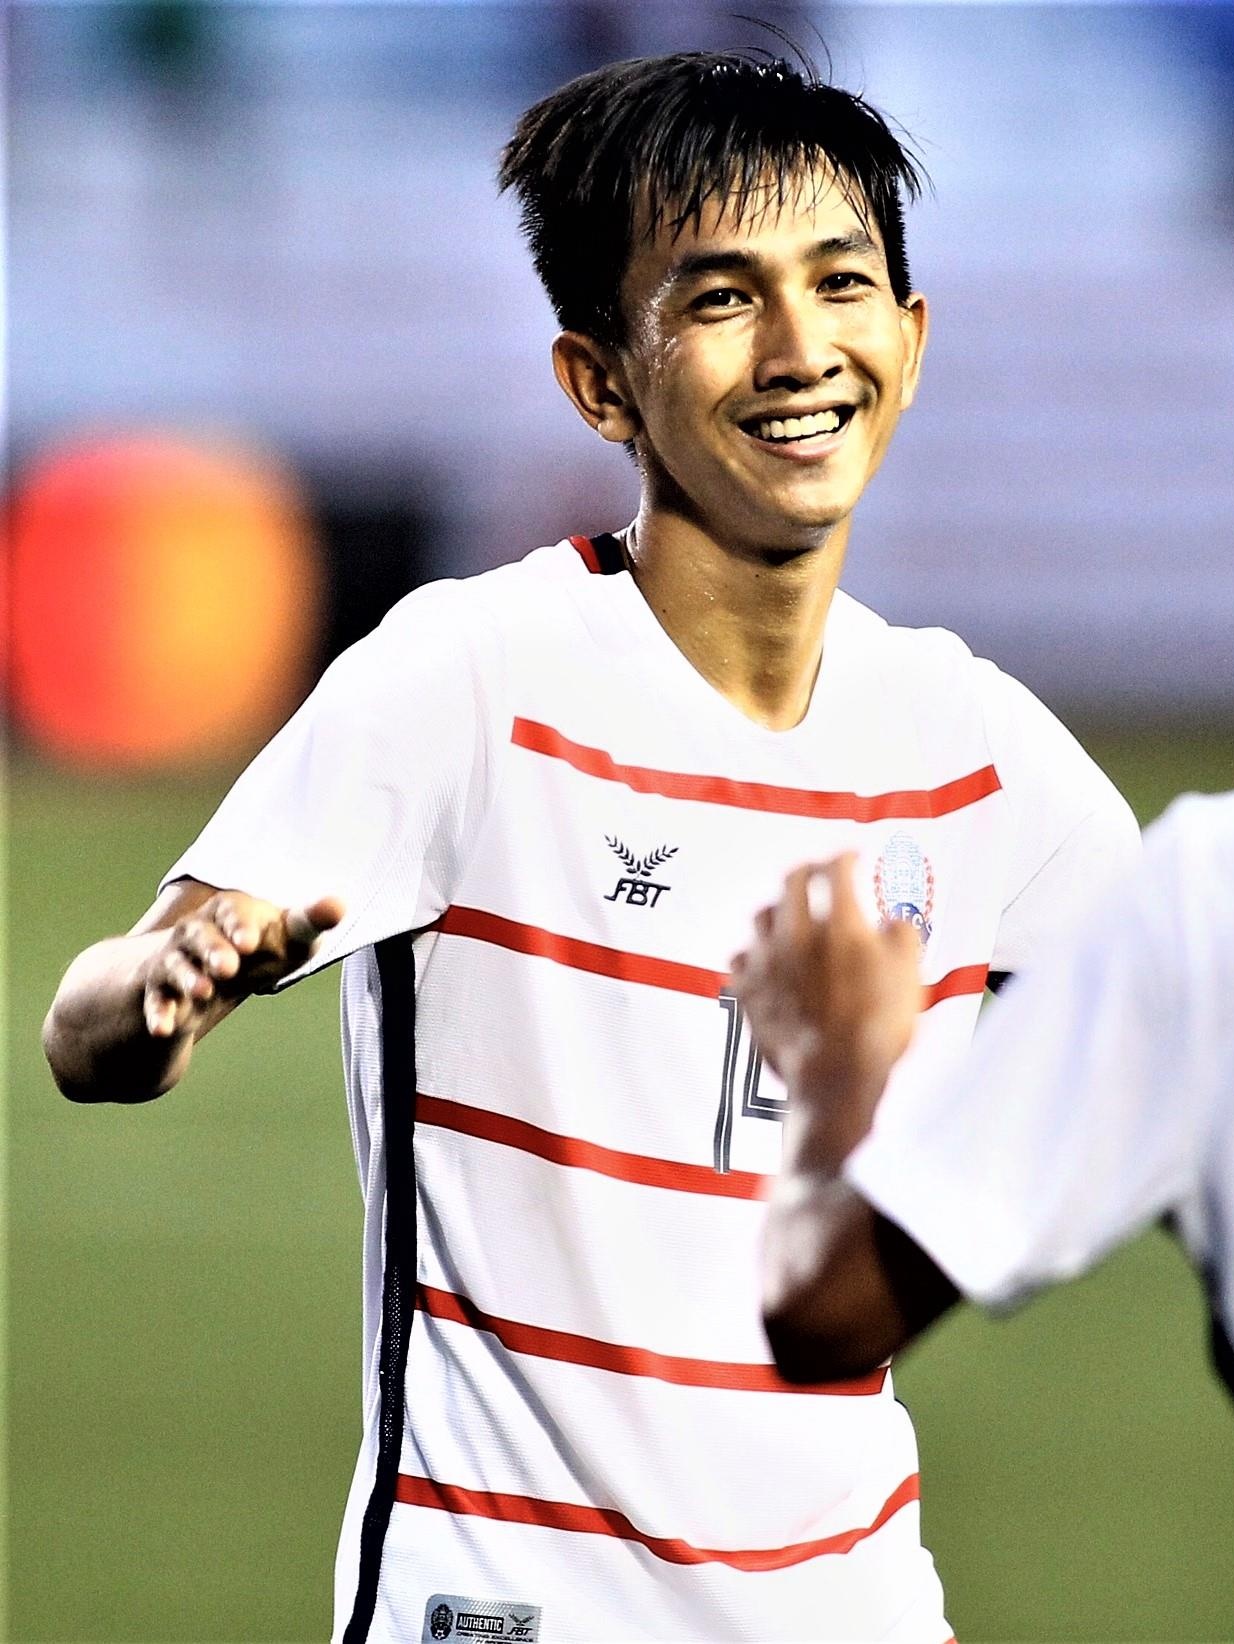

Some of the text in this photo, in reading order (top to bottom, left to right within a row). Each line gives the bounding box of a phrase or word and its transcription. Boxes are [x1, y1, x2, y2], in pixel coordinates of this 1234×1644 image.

[603, 877, 672, 908] FBT
[457, 1615, 503, 1632] AUTHENTIC
[507, 1626, 533, 1636] FBT
